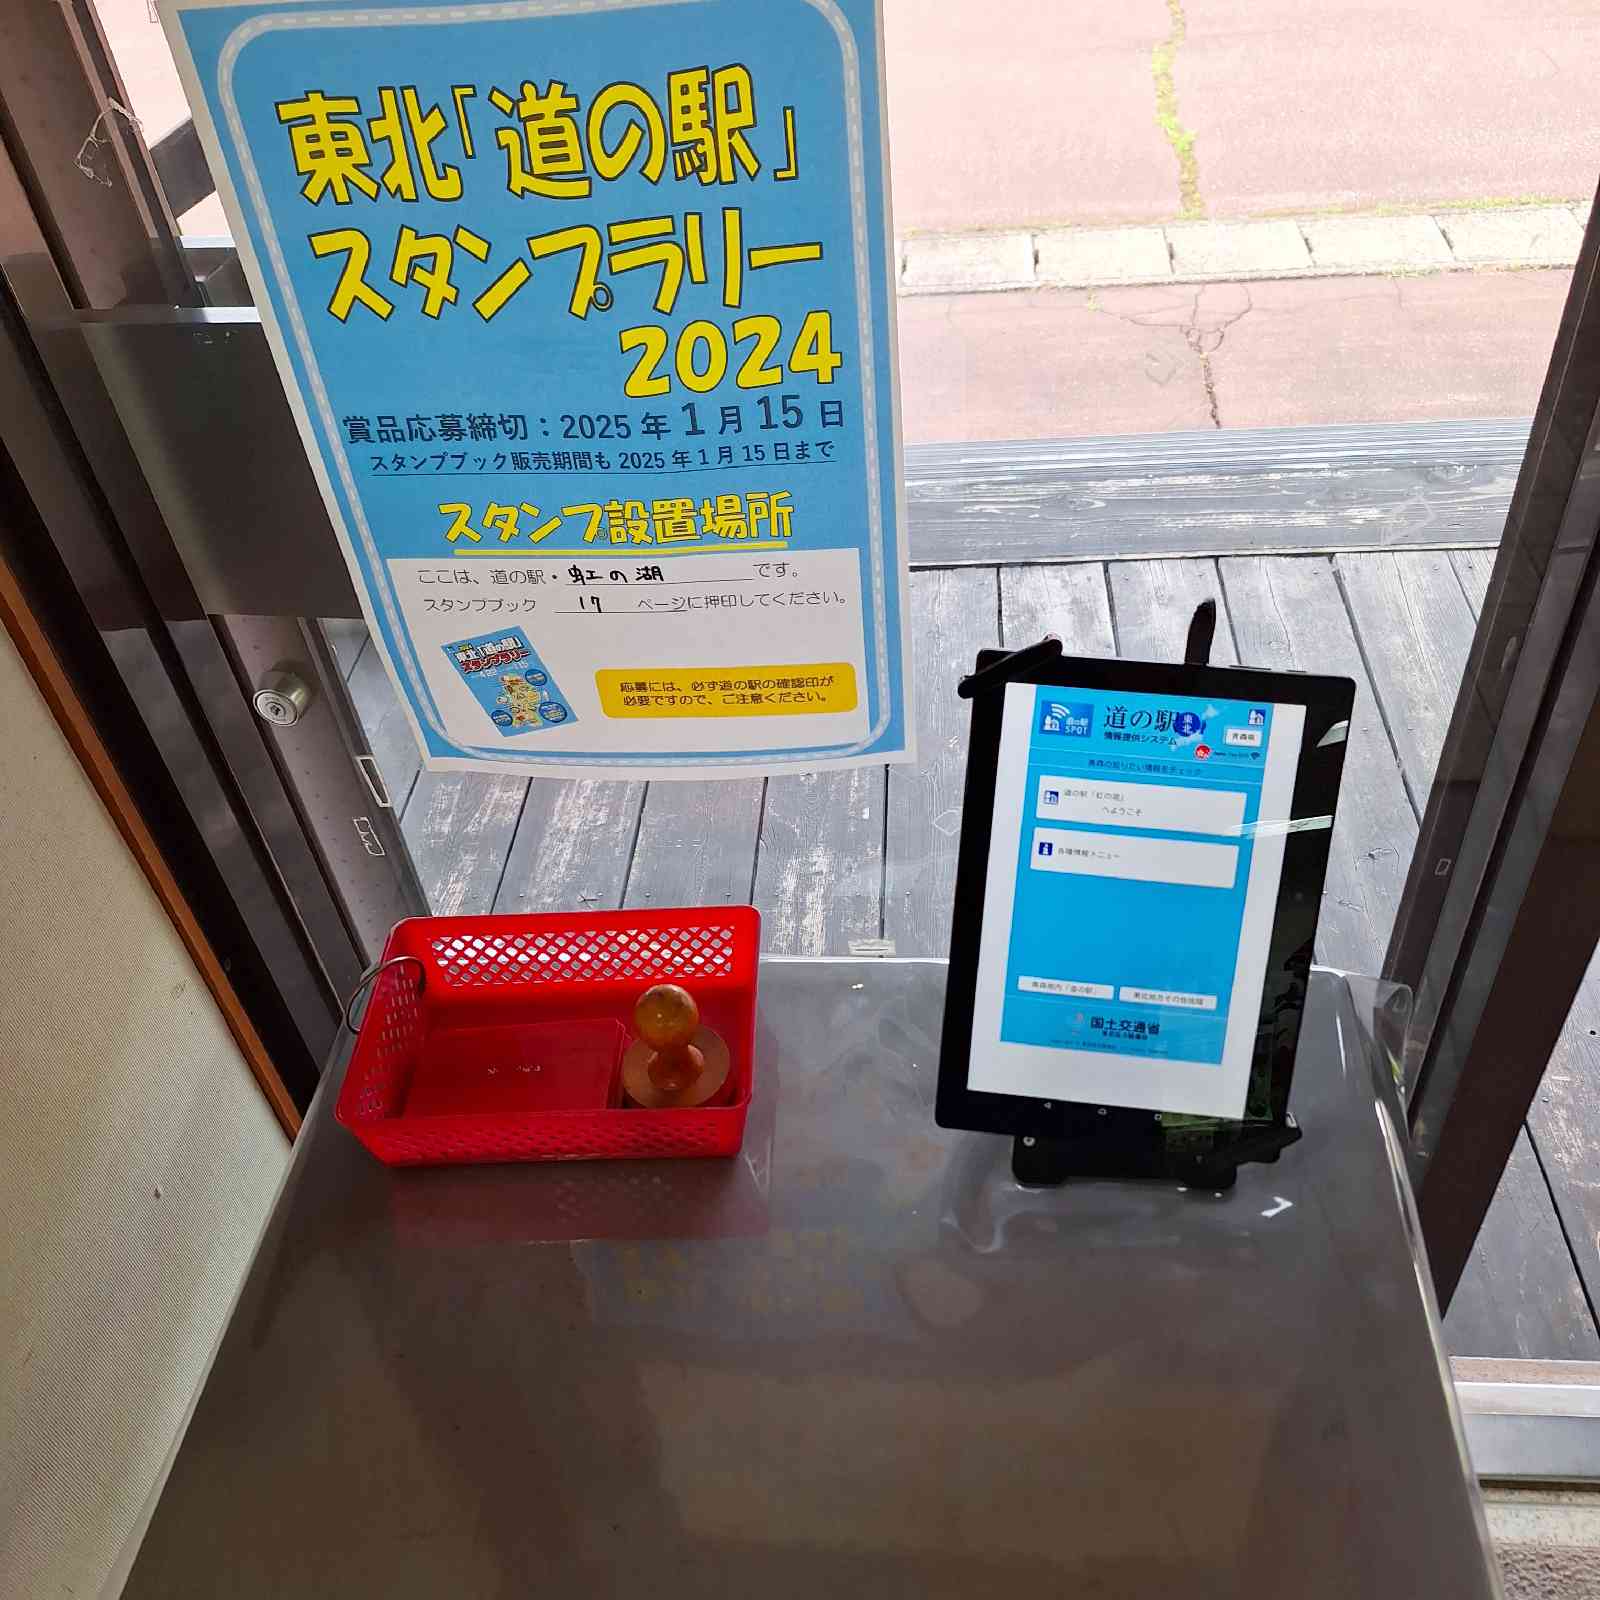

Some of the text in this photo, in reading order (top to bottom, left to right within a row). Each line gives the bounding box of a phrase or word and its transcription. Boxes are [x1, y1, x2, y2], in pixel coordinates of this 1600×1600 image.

[275, 63, 799, 205] 東北「道の駅」
[309, 207, 823, 323] スタンプラリー
[619, 310, 843, 399] 2024
[438, 490, 795, 544] スタンプ設置場所
[752, 562, 799, 578] です。
[424, 591, 846, 613] スタンプブック 17 ページに押印してください。
[1065, 725, 1089, 736] SPOT
[1103, 732, 1177, 746] 情報提供システム
[1090, 1016, 1160, 1035] 国土交通省
